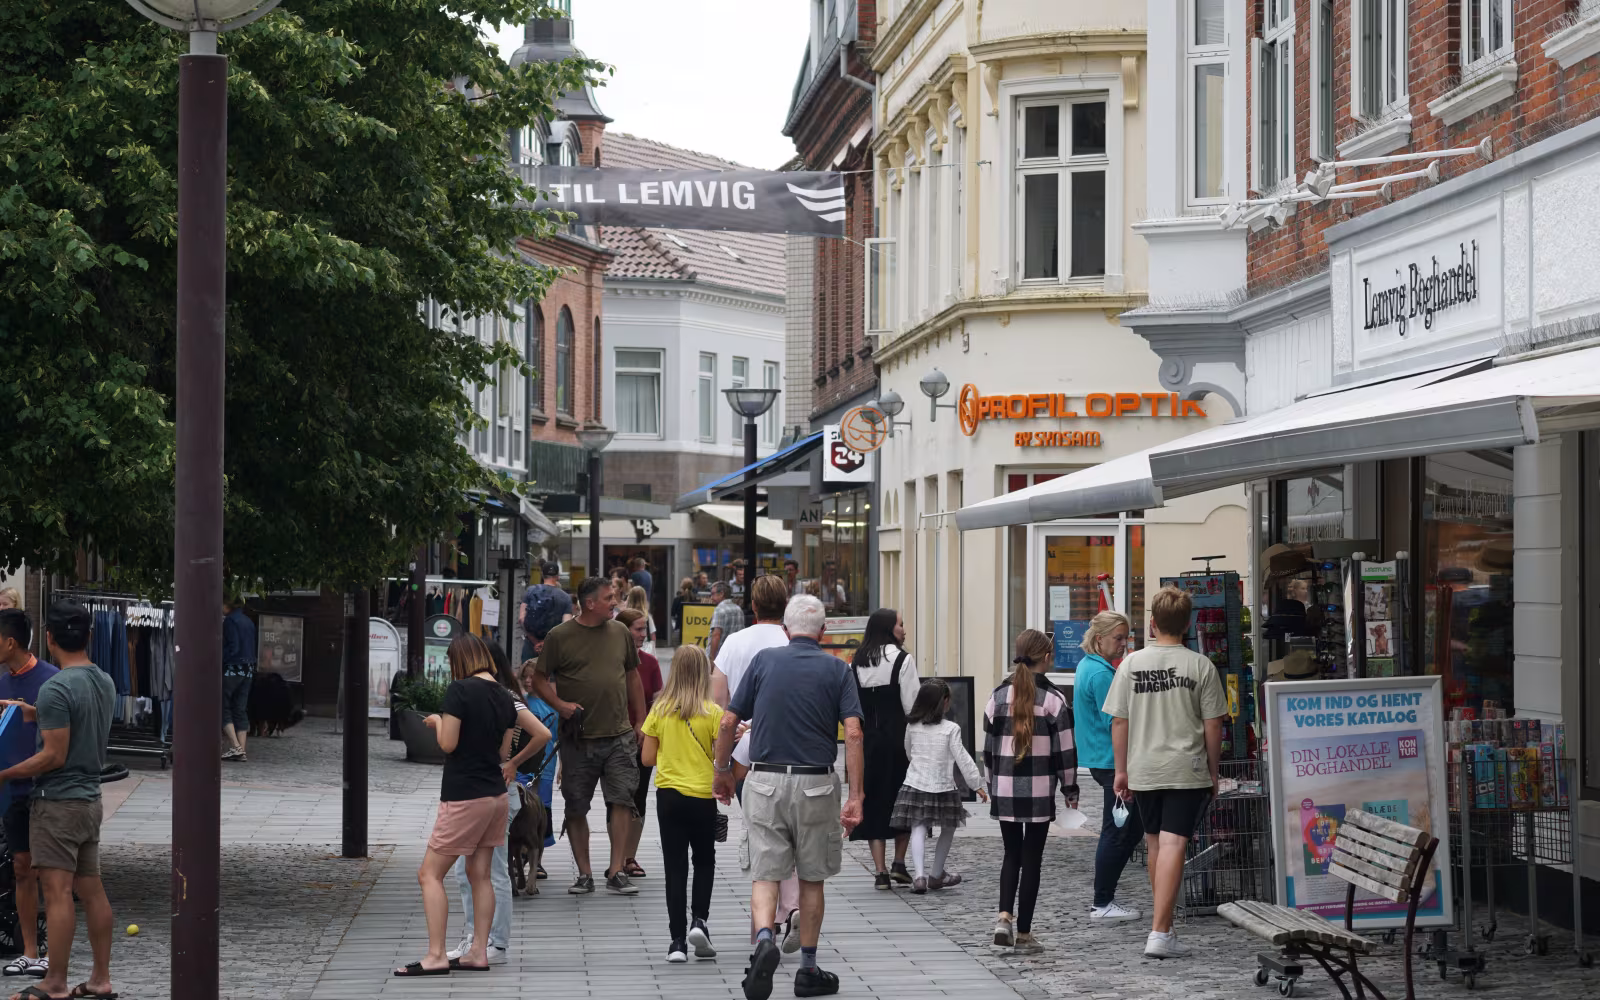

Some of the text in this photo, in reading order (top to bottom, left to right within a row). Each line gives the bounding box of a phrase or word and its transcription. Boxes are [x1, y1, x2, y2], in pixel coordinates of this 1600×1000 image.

[549, 183, 606, 203] TIL
[619, 180, 756, 210] LEMVIG
[1363, 239, 1479, 336] Lemvig Boghandel
[978, 392, 1208, 420] PROFIL OPTIK
[1014, 430, 1101, 447] BY SYNSAM
[834, 446, 863, 465] 24
[1131, 667, 1177, 682] INSIDE
[1133, 676, 1198, 694] IMAGINATION
[1287, 692, 1422, 712] KOM IND OG HENT
[1294, 709, 1417, 728] VORES KATALOG
[1290, 741, 1391, 764] DIN LOKALE
[1398, 739, 1416, 749] KON
[1400, 747, 1417, 757] TUR
[1296, 755, 1392, 777] BOGHANDEL
